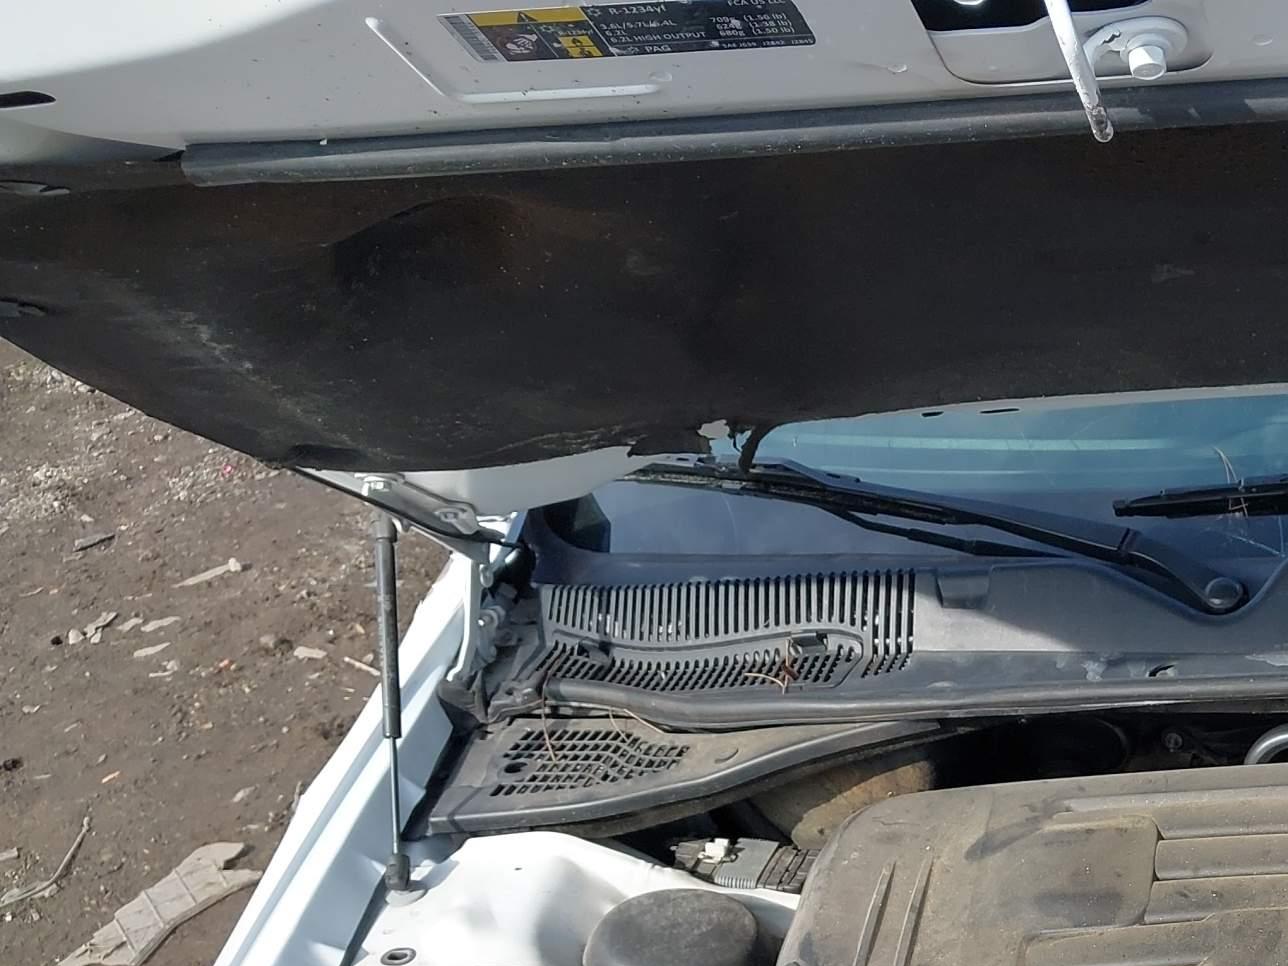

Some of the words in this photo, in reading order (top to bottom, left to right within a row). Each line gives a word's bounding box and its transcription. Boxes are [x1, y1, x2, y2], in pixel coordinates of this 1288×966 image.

[608, 4, 667, 16] R-1234yf
[604, 29, 627, 37] 6.2L
[633, 34, 661, 42] HIGH
[663, 31, 707, 40] OUTPUT
[644, 44, 672, 53] PAG
